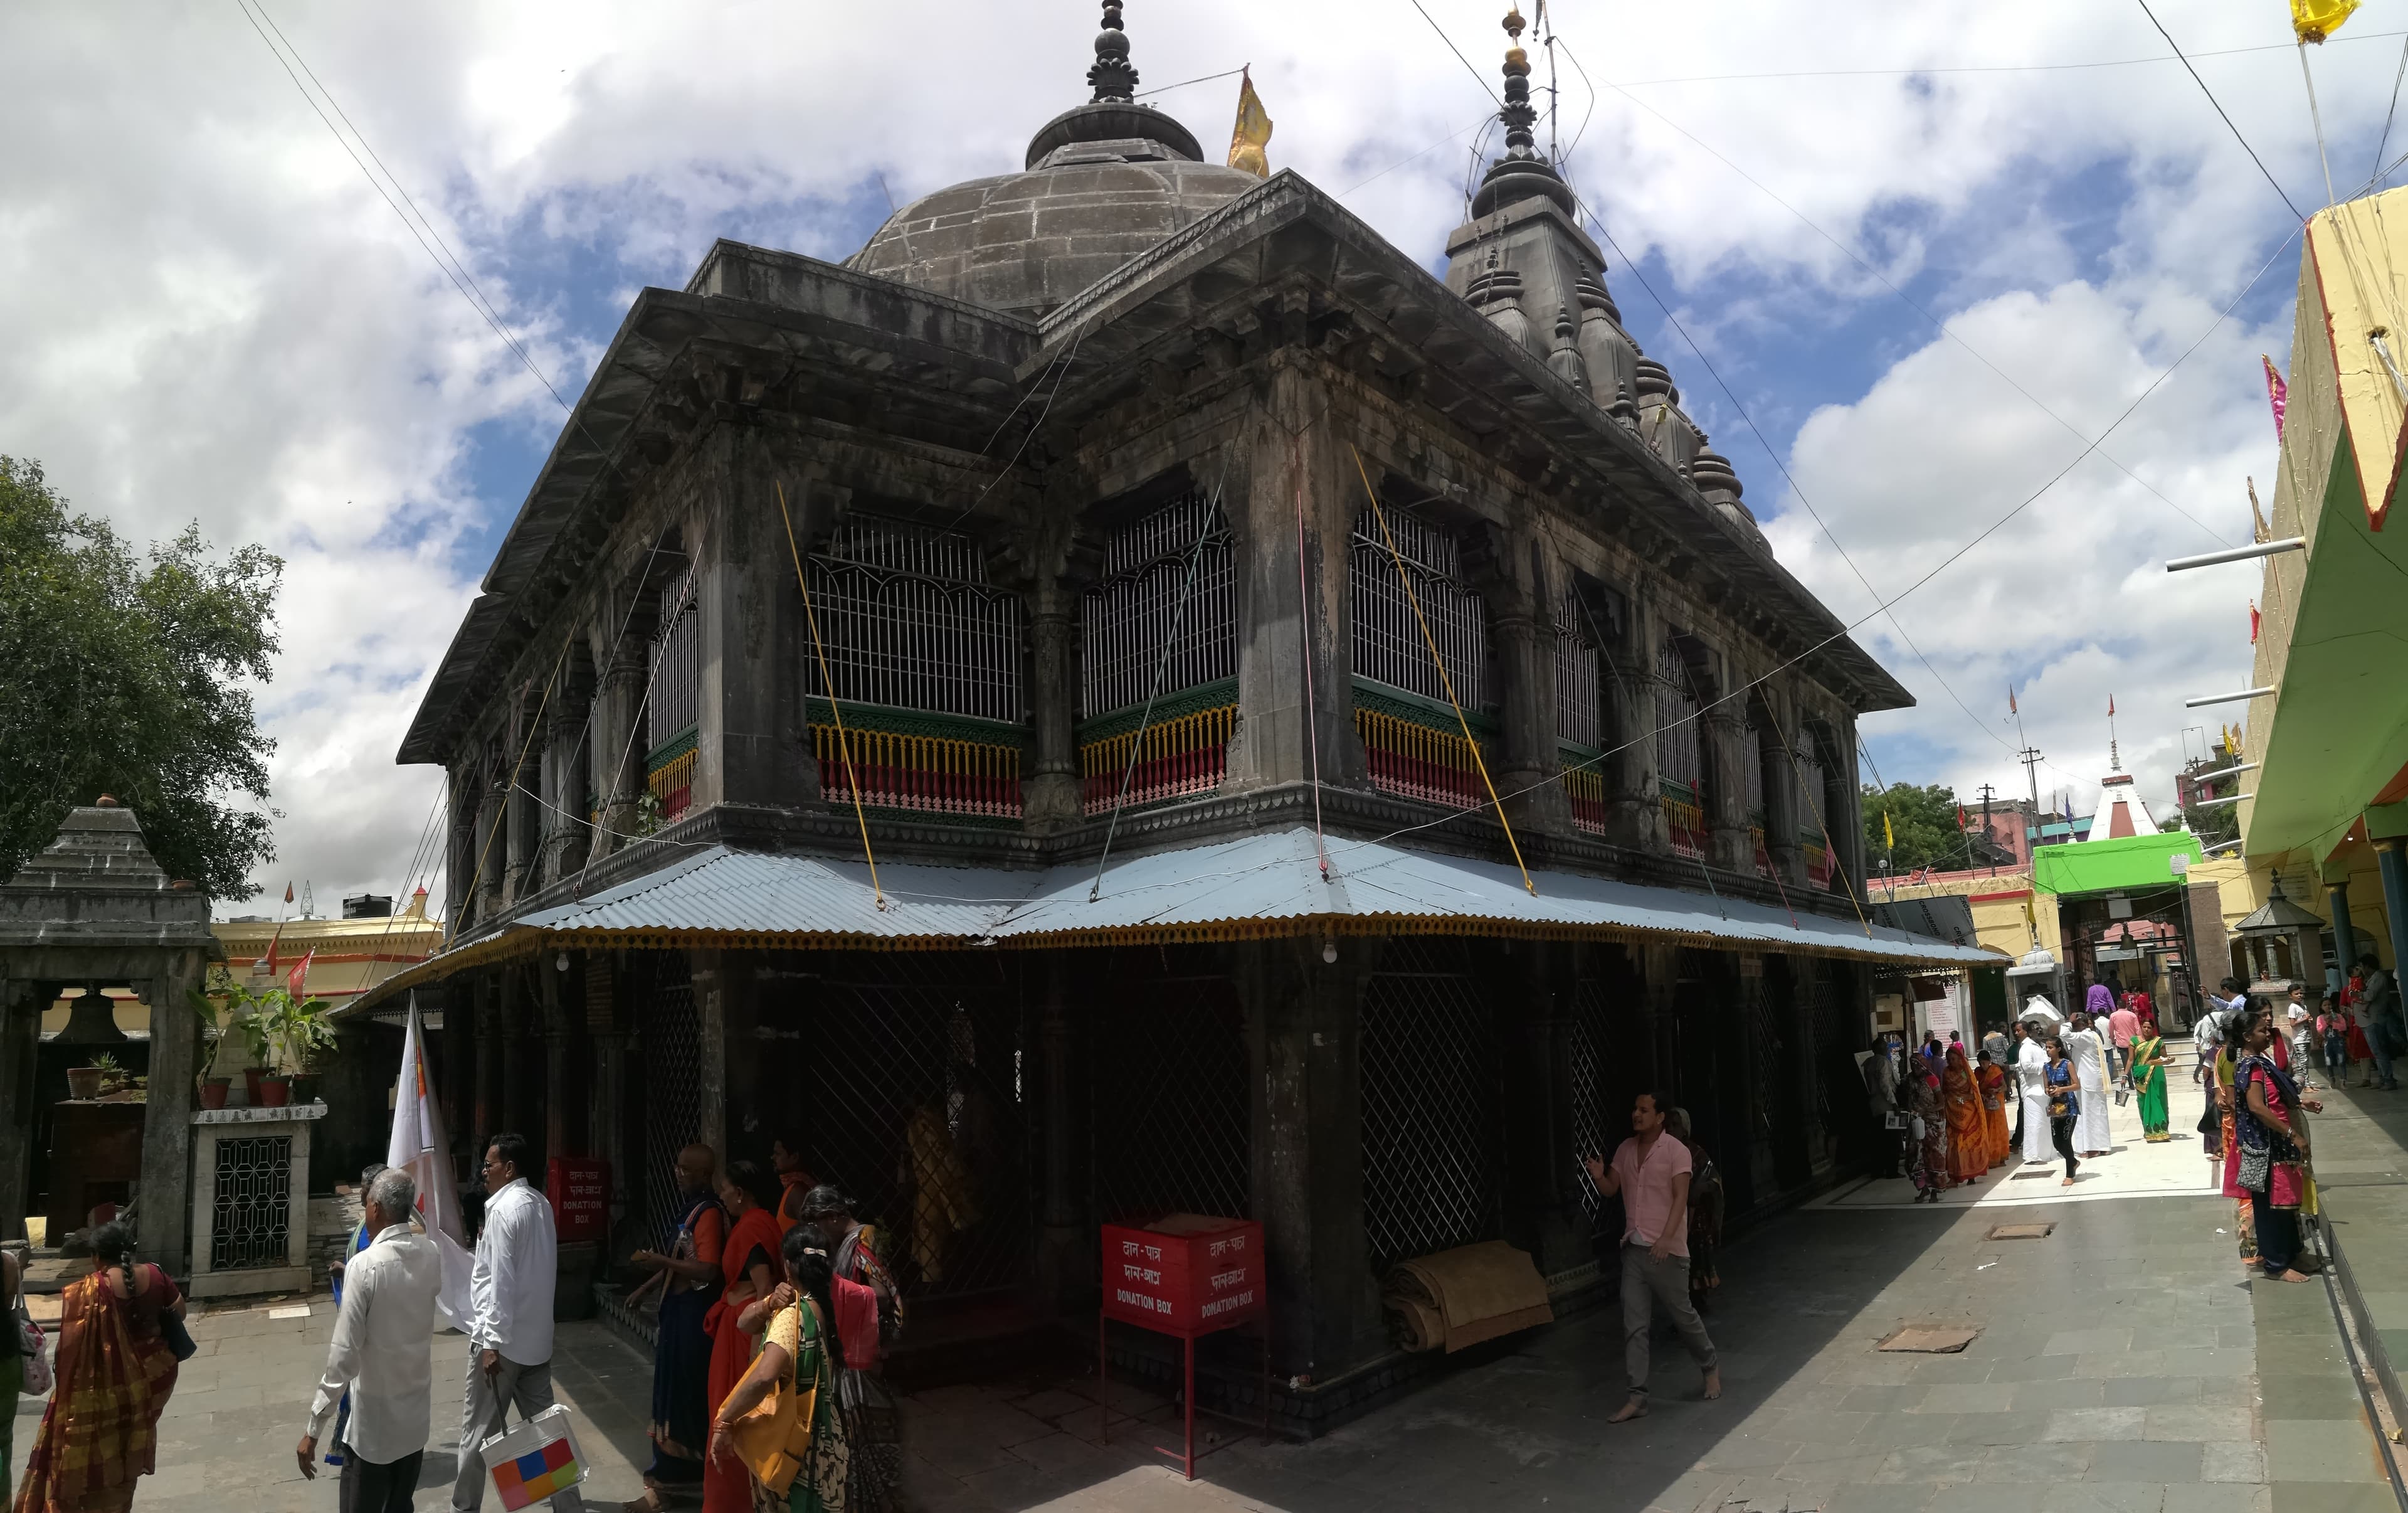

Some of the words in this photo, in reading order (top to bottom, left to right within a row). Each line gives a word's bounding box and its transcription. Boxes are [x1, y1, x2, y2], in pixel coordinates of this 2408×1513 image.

[1918, 900, 1940, 936] CROSSBOND
[563, 1200, 603, 1210] DONATION
[574, 1214, 589, 1224] BOX
[1117, 1288, 1154, 1310] DONATION
[1156, 1299, 1172, 1315] BOX
[1201, 1297, 1238, 1319] DONATION
[1238, 1290, 1254, 1307] BOX
